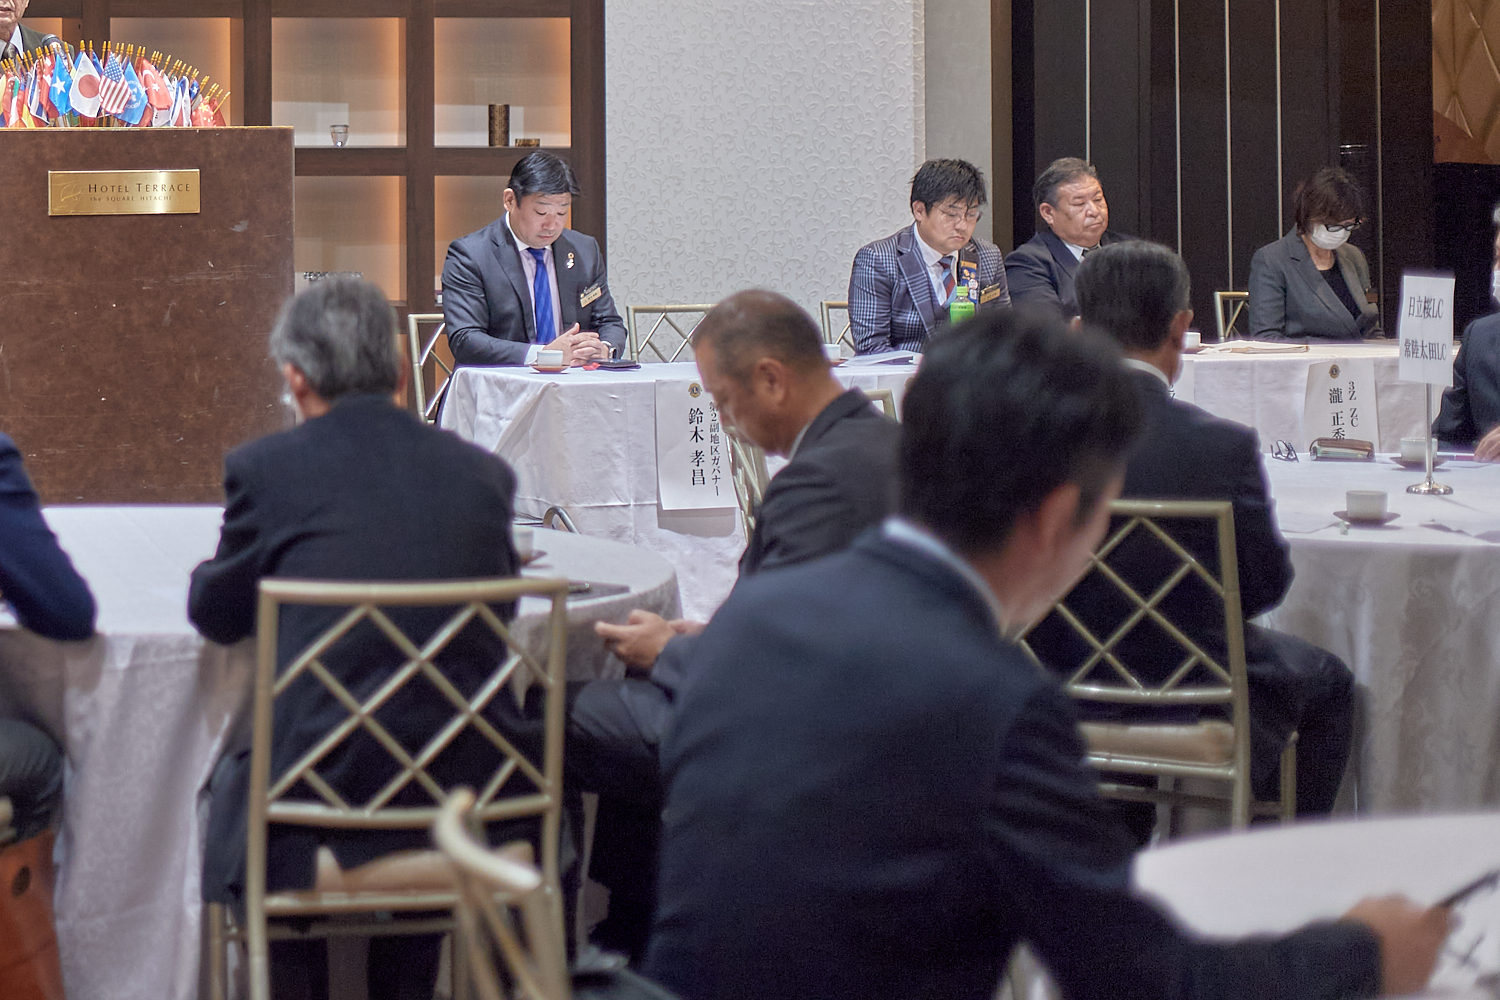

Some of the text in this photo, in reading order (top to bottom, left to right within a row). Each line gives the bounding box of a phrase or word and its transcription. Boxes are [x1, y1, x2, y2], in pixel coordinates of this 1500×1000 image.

[88, 182, 190, 193] HOTEL TERRACE
[688, 407, 706, 486] 鈴木 孝昌
